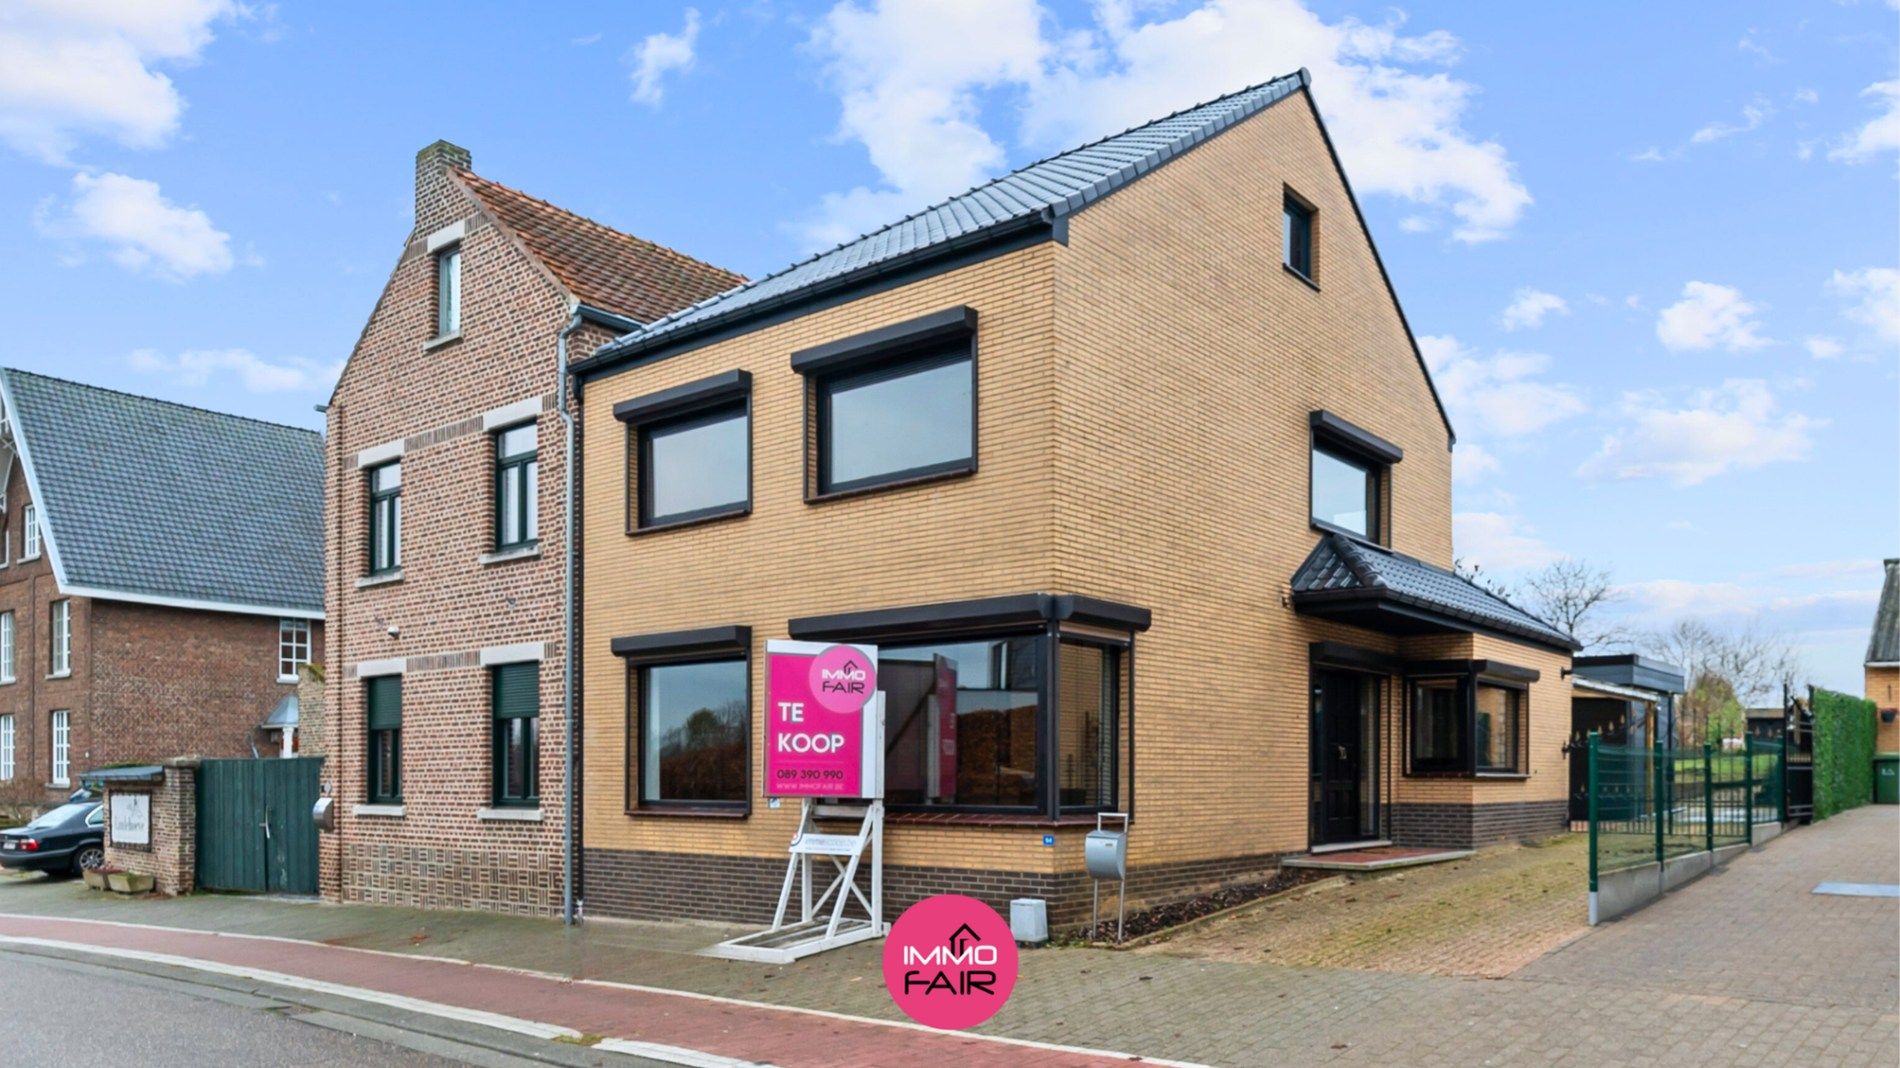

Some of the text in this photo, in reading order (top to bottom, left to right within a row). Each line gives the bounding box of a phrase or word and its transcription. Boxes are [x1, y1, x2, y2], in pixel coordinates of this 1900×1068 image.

[822, 669, 866, 681] IMMO
[822, 681, 865, 694] FAIR
[777, 702, 804, 722] TE
[778, 732, 845, 753] KOOP
[777, 769, 843, 780] 089 390 990
